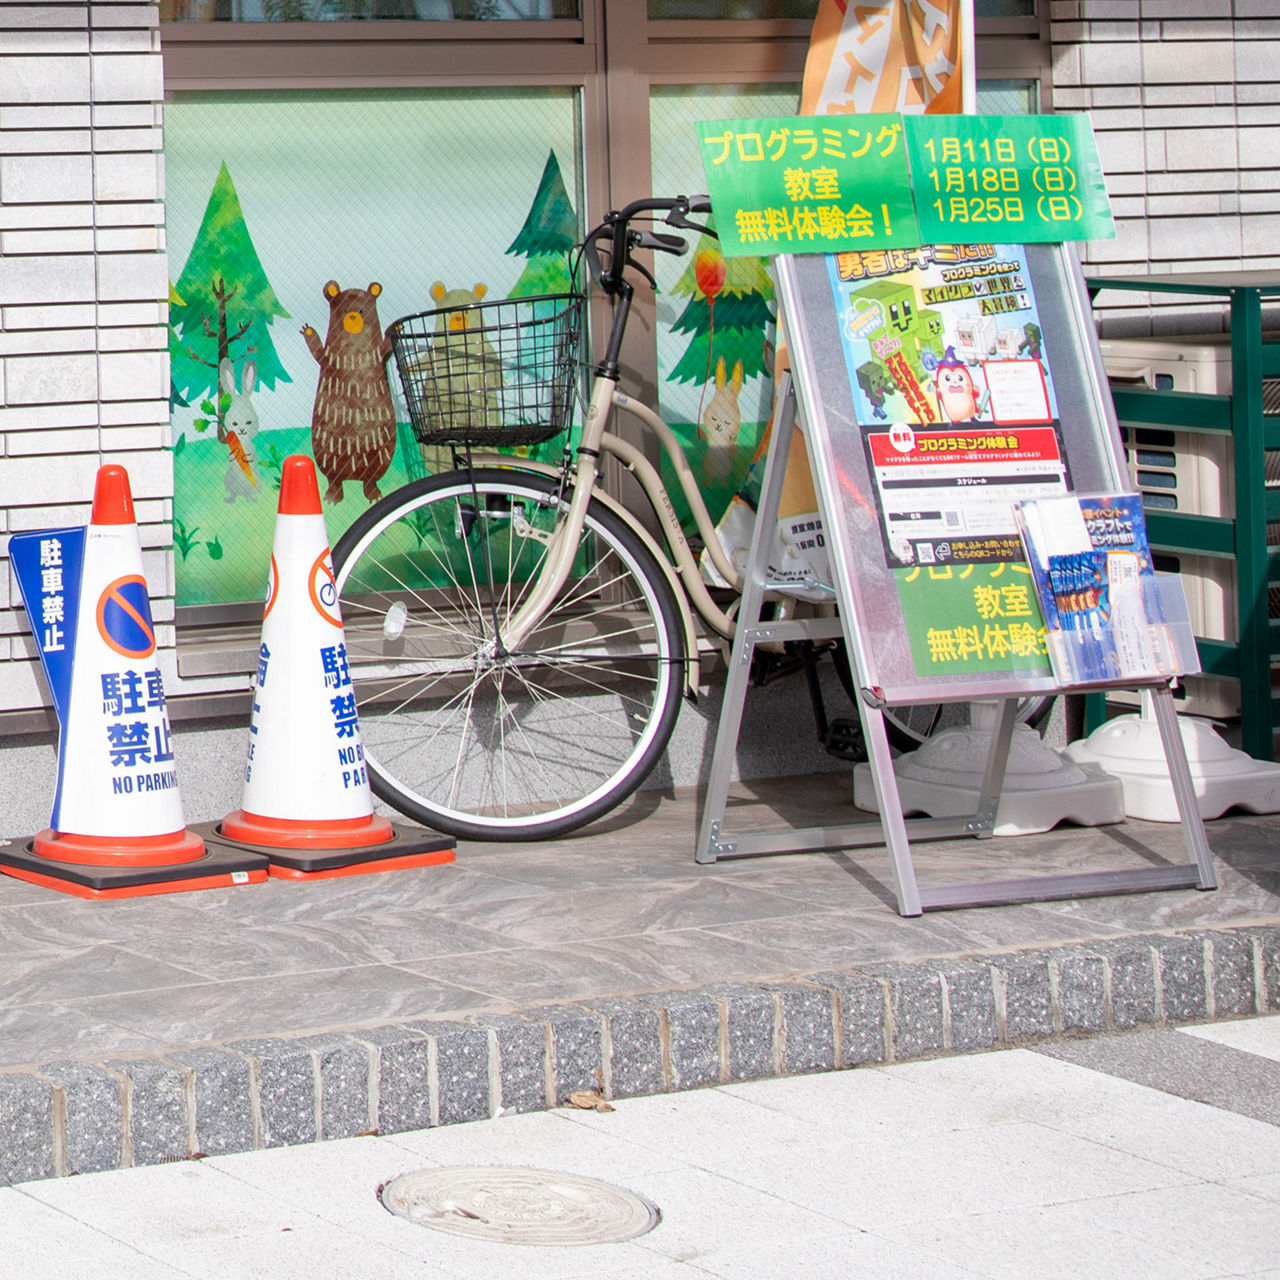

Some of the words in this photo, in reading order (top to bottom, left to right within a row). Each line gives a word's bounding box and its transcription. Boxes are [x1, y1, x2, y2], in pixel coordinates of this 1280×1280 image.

[704, 123, 902, 164] プログラミング
[783, 167, 842, 202] 教室
[734, 202, 893, 243] 無料体験会!
[917, 436, 1019, 452] プログラミング体験会
[40, 538, 65, 653] 駐車禁止
[974, 583, 1032, 619] 教室
[338, 746, 355, 766] NO
[112, 776, 133, 794] NO
